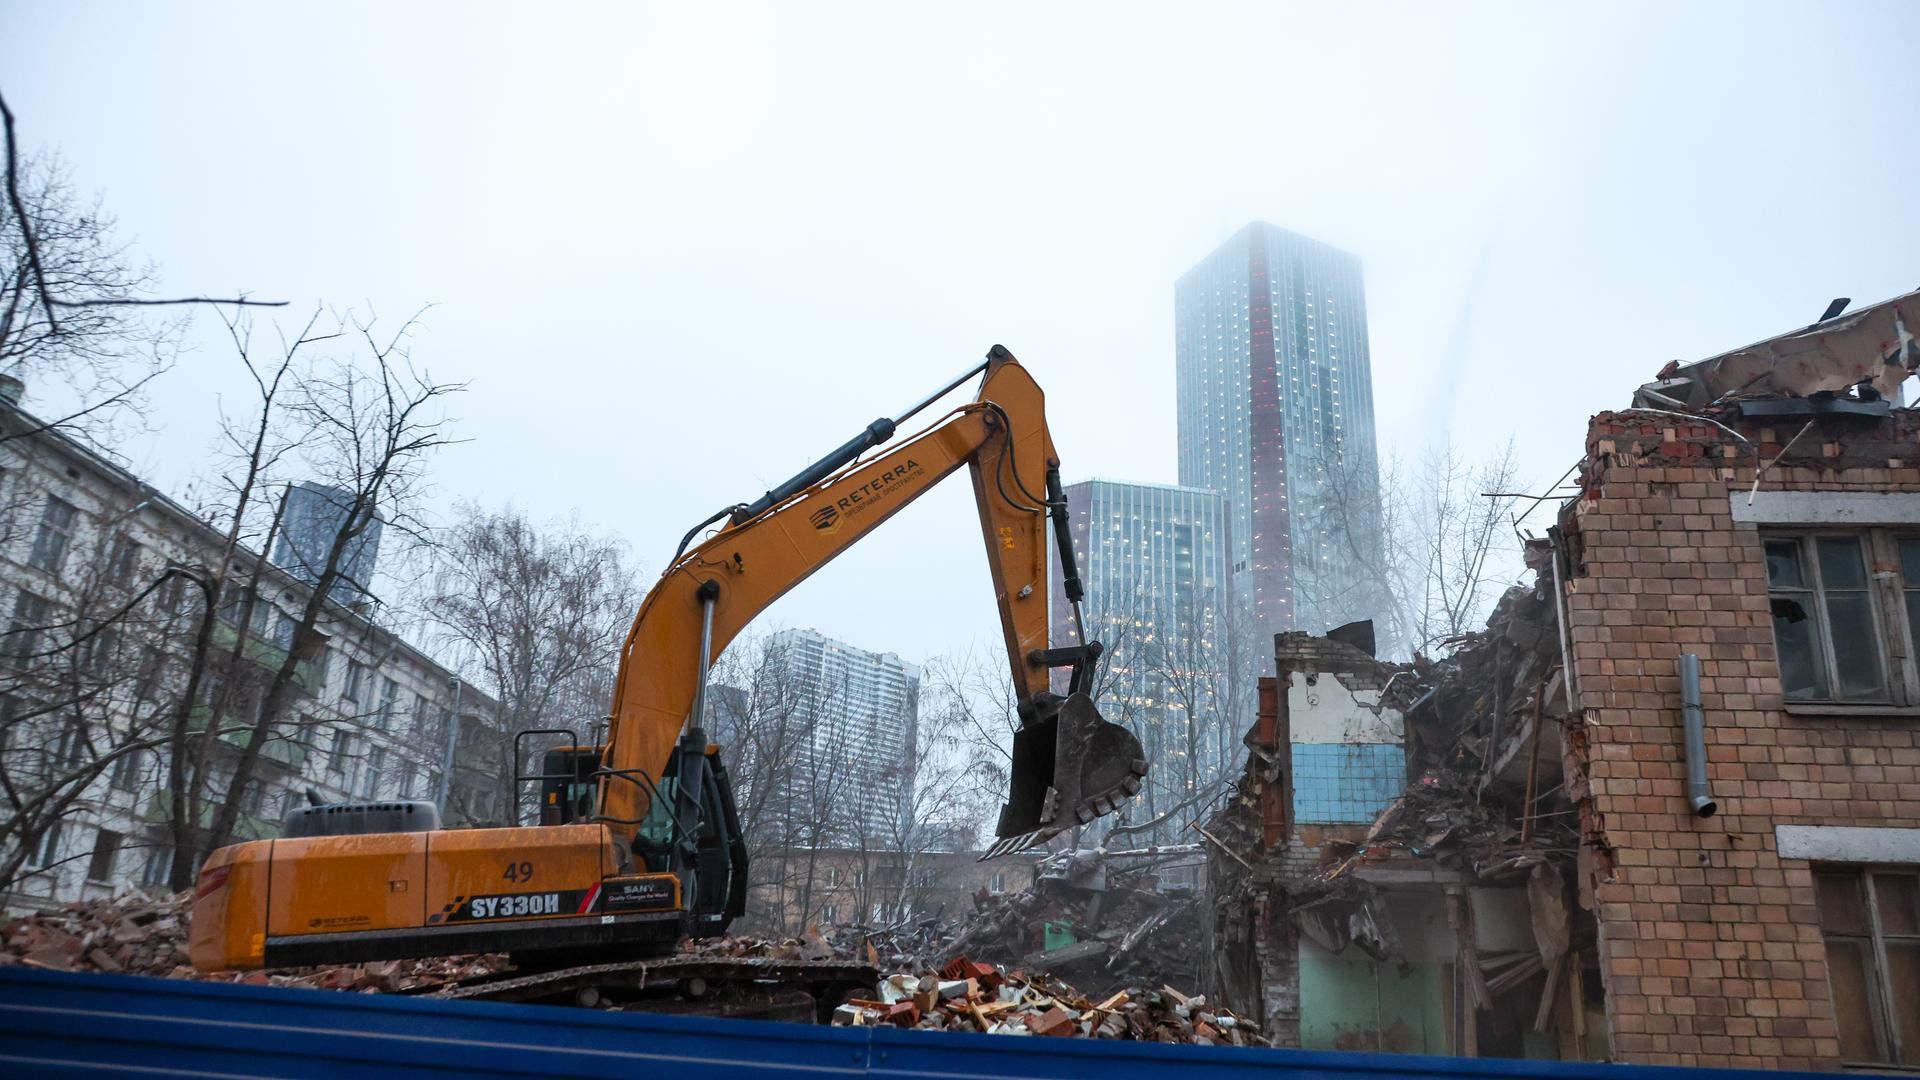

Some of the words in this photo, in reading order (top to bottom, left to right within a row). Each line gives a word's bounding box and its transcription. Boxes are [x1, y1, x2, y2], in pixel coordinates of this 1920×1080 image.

[837, 460, 919, 510] RETERRA
[503, 862, 534, 883] 49
[623, 884, 655, 894] SANY
[471, 894, 559, 918] SY330H
